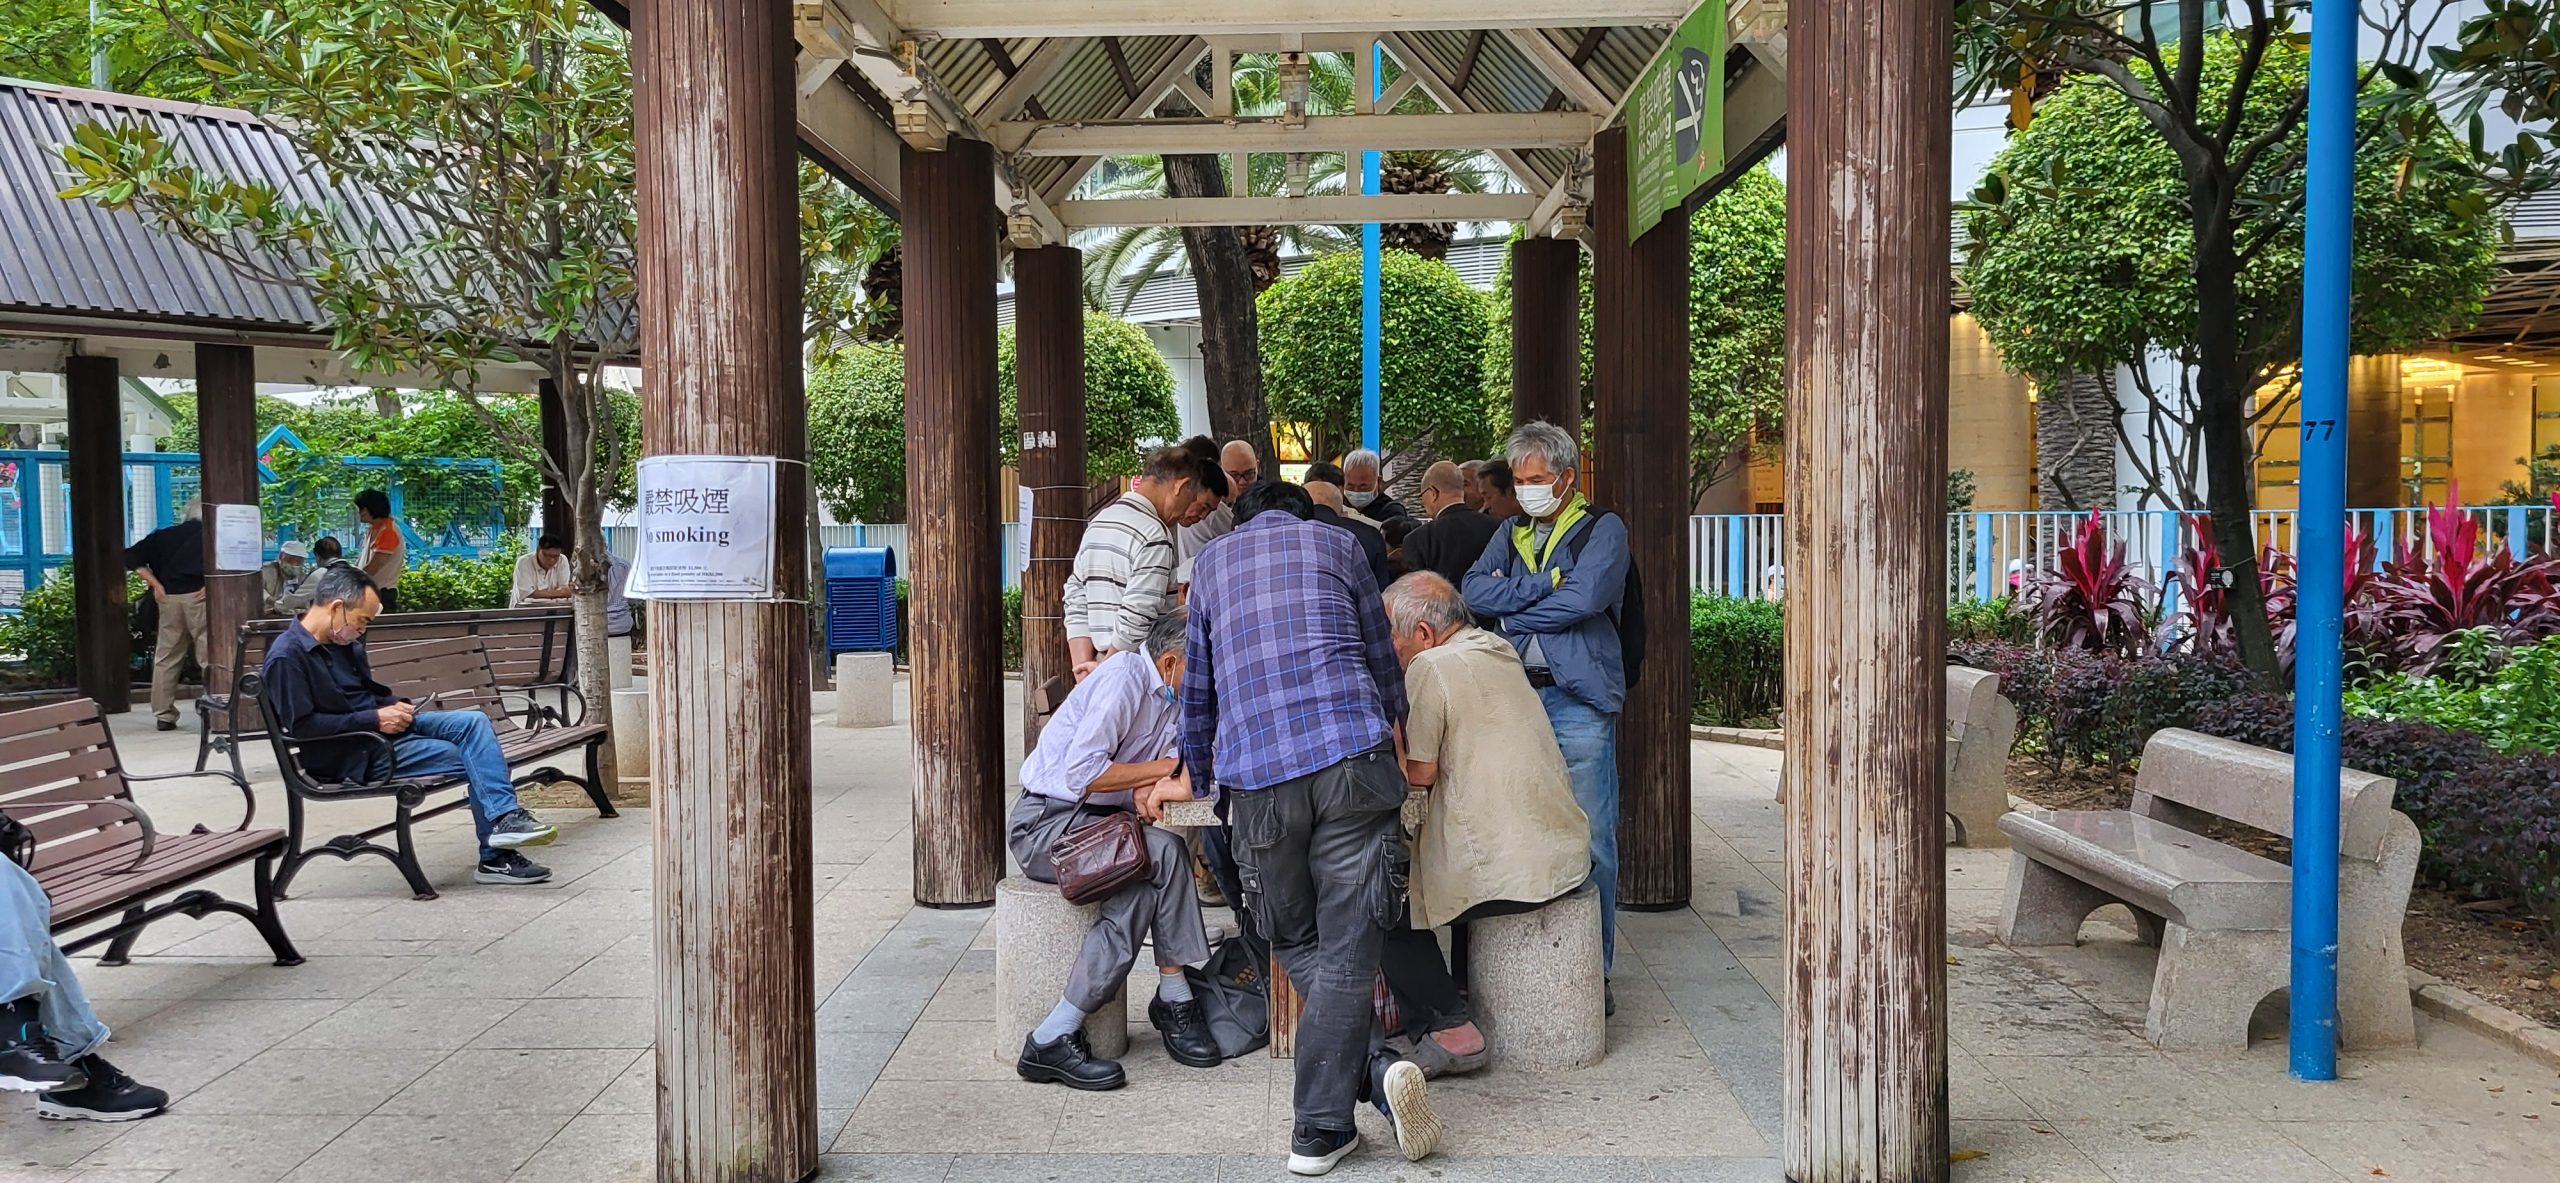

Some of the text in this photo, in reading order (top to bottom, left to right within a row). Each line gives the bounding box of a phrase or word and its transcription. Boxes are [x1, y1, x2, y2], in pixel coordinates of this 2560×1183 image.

[1639, 59, 1672, 137] 嚴禁吸煙
[2304, 420, 2336, 442] 77
[655, 526, 730, 547] smoking
